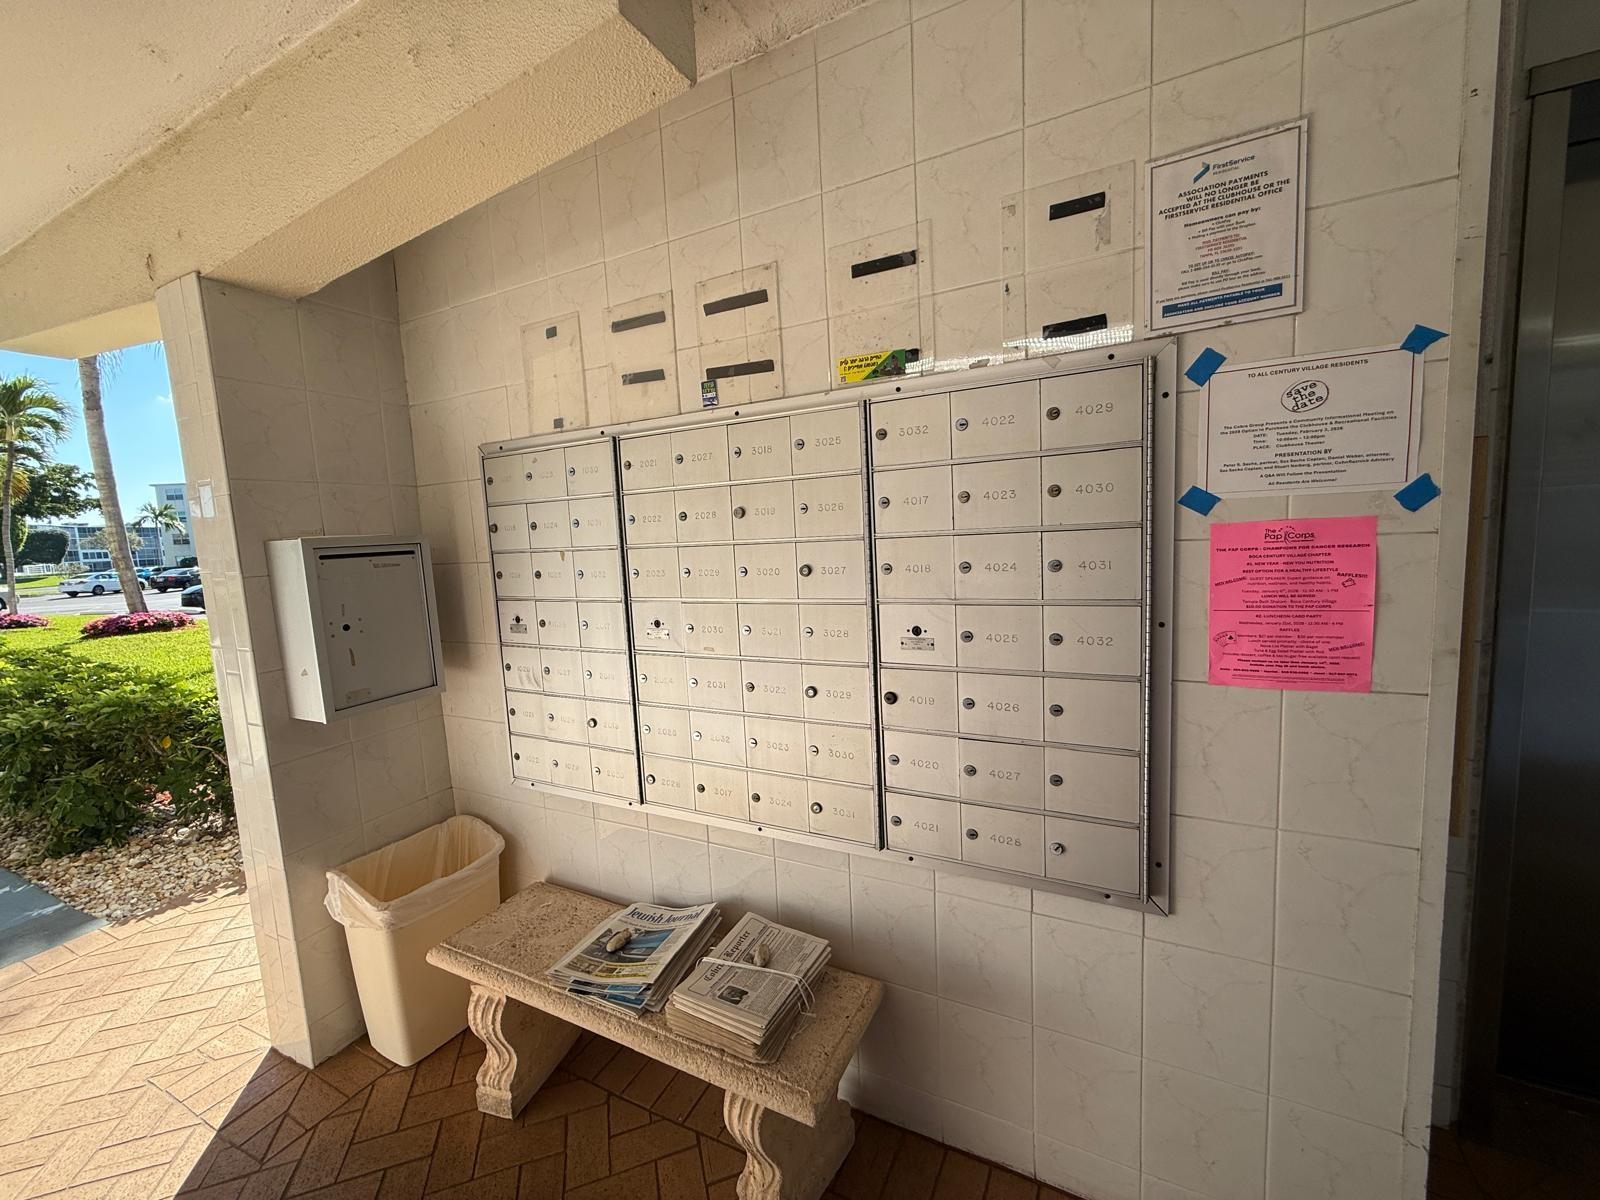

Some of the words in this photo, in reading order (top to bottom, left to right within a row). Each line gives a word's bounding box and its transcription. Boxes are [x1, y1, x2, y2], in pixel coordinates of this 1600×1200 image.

[1212, 155, 1255, 170] FirstService
[1178, 182, 1226, 198] ASSOCIATION
[1228, 171, 1268, 185] PAYMENTS
[1218, 182, 1248, 194] LONGER
[1159, 202, 1191, 215] ACCEPTED
[1218, 185, 1261, 201] CLUBHOUSE
[1277, 178, 1290, 186] THE
[1165, 205, 1209, 220] FIRSTSERVICE
[1211, 195, 1255, 209] RESIDENTIAL
[1258, 187, 1283, 198] OFFICE
[1184, 215, 1223, 228] Homeowners
[1237, 209, 1249, 218] pay
[1270, 367, 1300, 376] CENTURY
[1301, 363, 1328, 371] VILLAGE
[1330, 359, 1368, 368] RESIDENTS
[1286, 381, 1318, 398] save
[1292, 389, 1317, 404] the
[1075, 402, 1114, 415] 4029
[1291, 394, 1324, 412] date
[981, 414, 1015, 427] 4022
[898, 425, 929, 437] 3032
[815, 436, 841, 446] 3025
[751, 446, 773, 455] 3018
[691, 452, 713, 463] 2027
[639, 460, 657, 468] 2021
[1075, 482, 1114, 494] 4030
[903, 495, 929, 506] 4017
[983, 490, 1017, 500] 4023
[754, 507, 776, 517] 3019
[642, 515, 662, 523] 2022
[821, 566, 846, 575] 3027
[905, 564, 931, 573] 4018
[984, 562, 1017, 572] 4024
[1079, 560, 1112, 571] 4031
[756, 567, 780, 576] 3020
[701, 625, 724, 634] 2030
[823, 629, 849, 638] 3028
[986, 633, 1018, 643] 4025
[1077, 636, 1113, 647] 4032
[706, 680, 727, 689] 2031
[826, 690, 852, 699] 3029
[909, 696, 935, 705] 4019
[987, 701, 1020, 713] 4026
[767, 741, 789, 751] 3023
[828, 750, 855, 760] 3030
[910, 759, 939, 770] 4020
[989, 770, 1021, 781] 4027
[768, 798, 792, 807] 3024
[832, 807, 856, 818] 3031
[914, 821, 940, 833] 4021
[990, 834, 1022, 847] 4028
[627, 907, 664, 924] Jewish
[664, 908, 704, 924] Journal
[724, 931, 751, 958] Reporter
